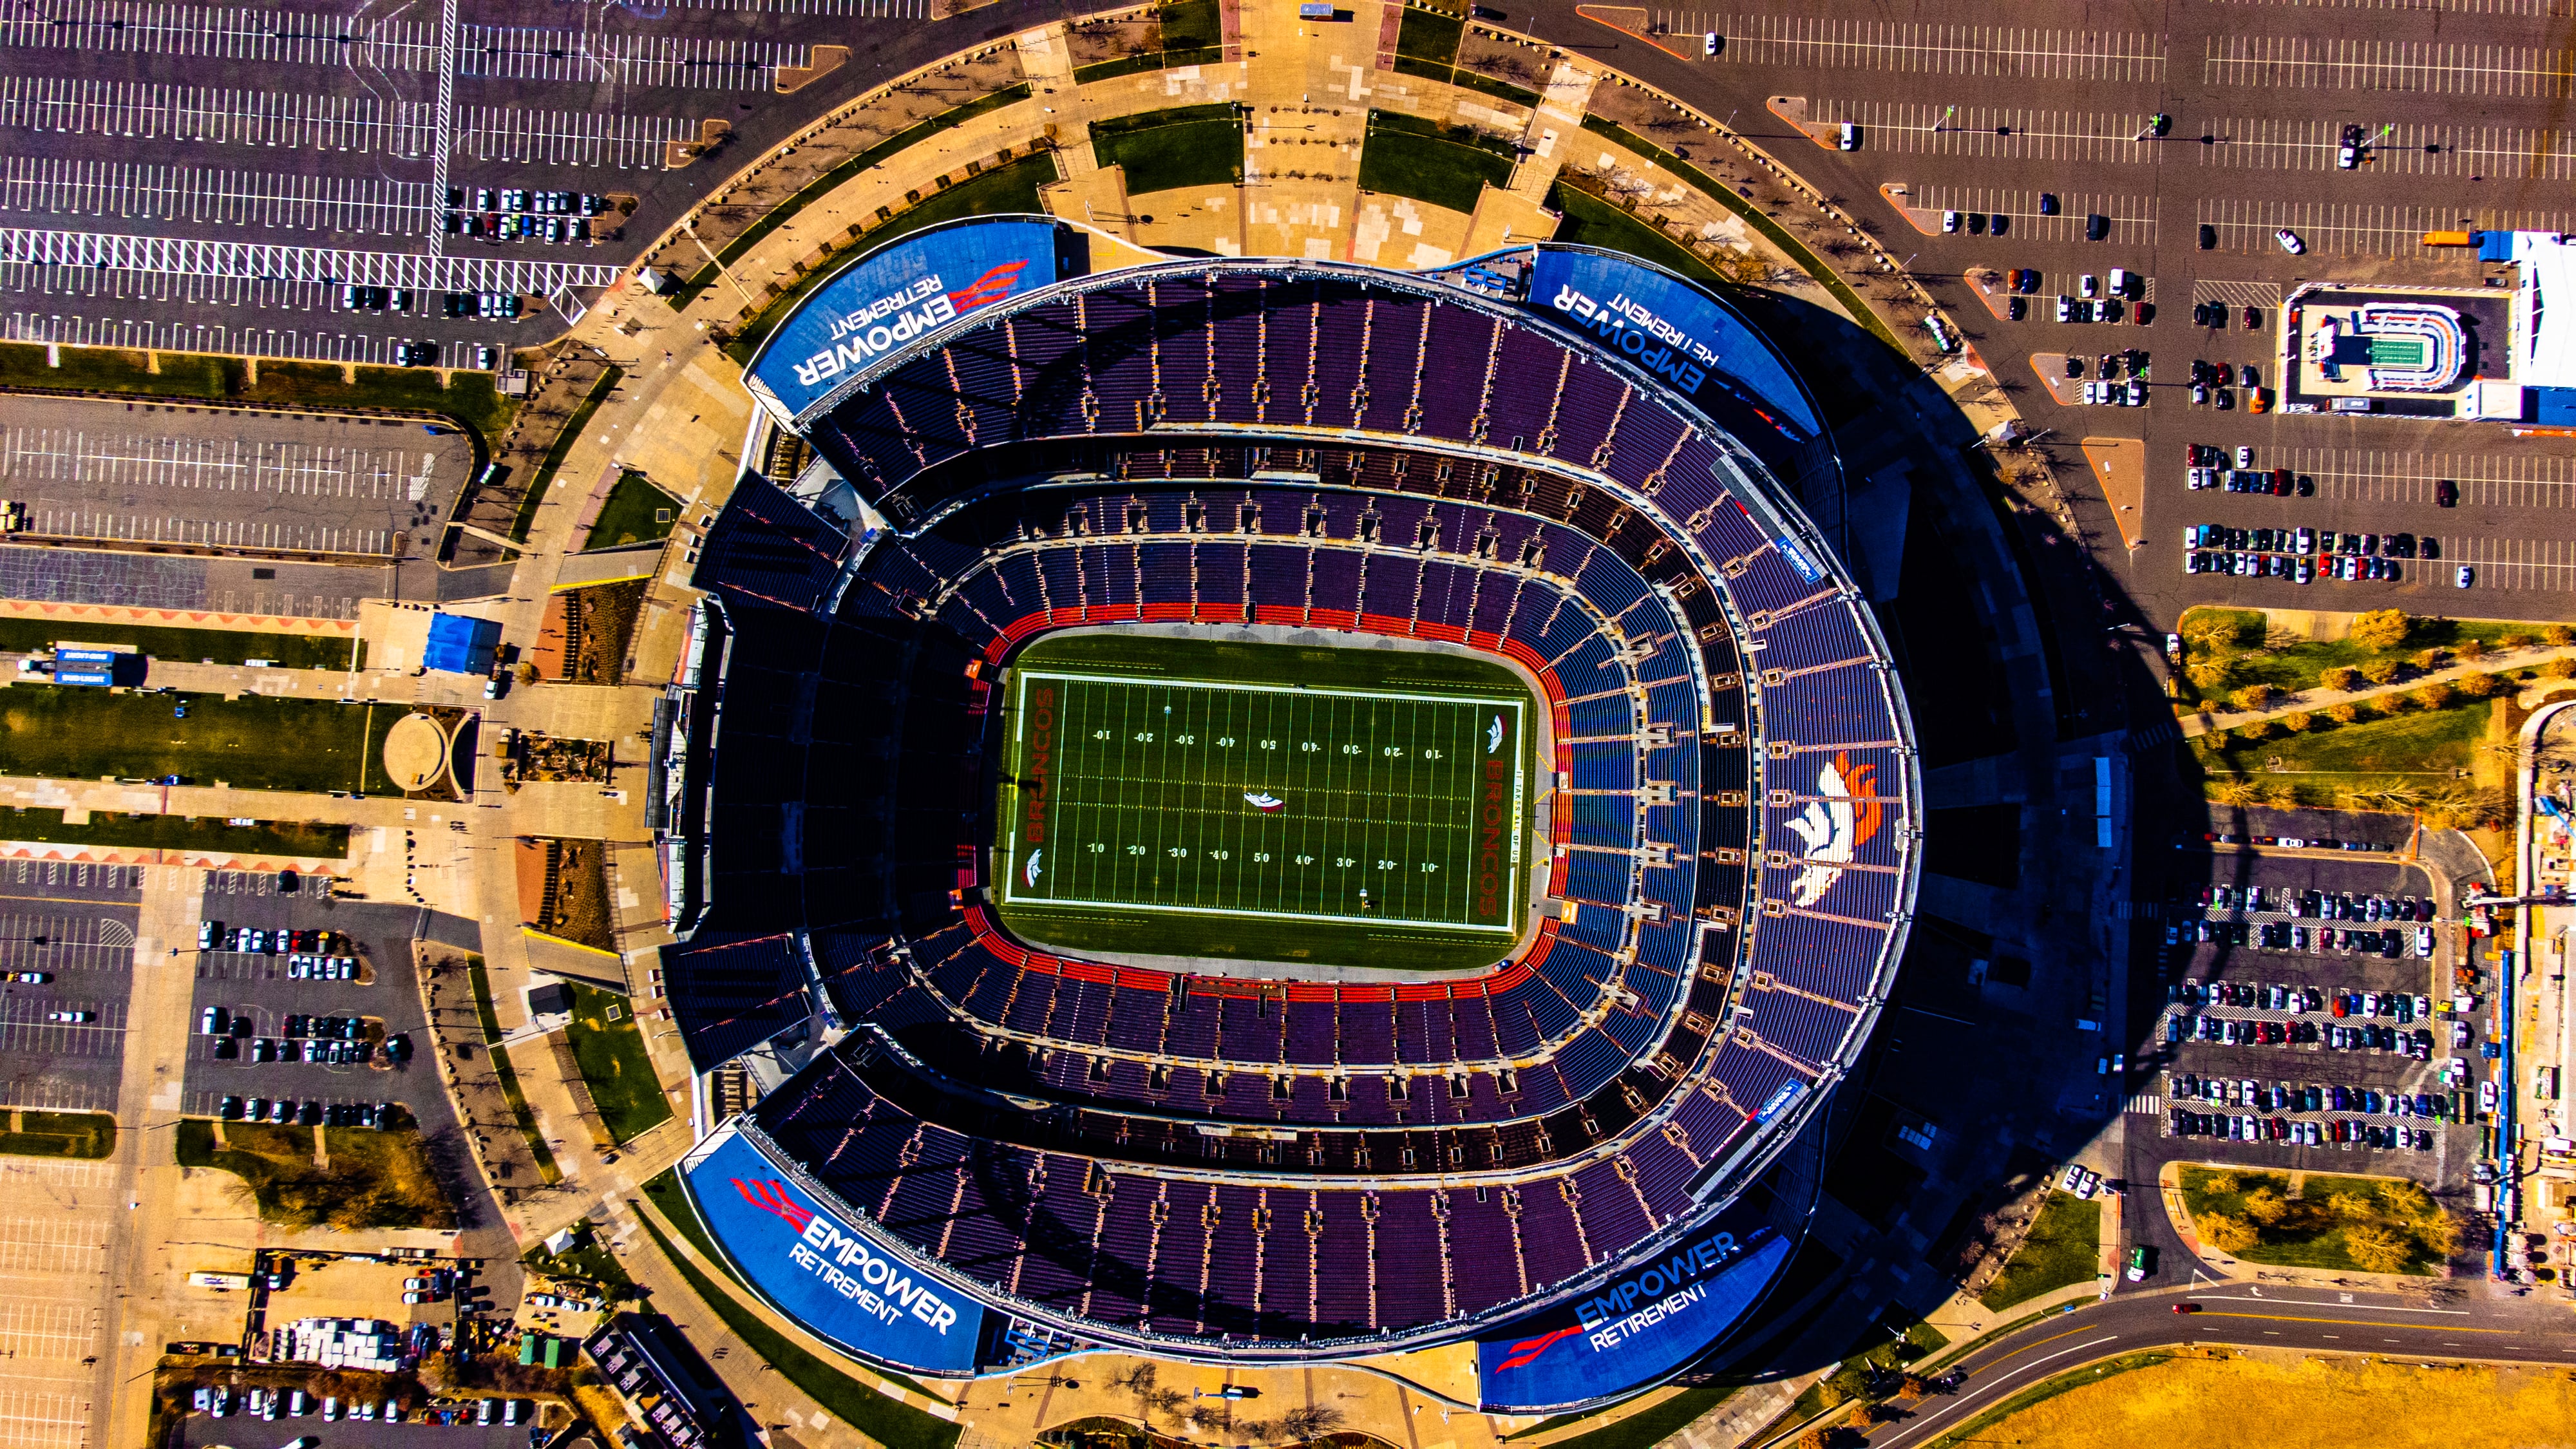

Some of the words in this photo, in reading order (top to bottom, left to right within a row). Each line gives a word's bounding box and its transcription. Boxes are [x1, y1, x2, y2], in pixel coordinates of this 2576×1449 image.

[830, 274, 943, 341] RETIREMENT
[1606, 293, 1720, 366] RETIREMENT
[792, 294, 956, 386] EMPOWER
[1553, 284, 1706, 394] EMPOWER
[1097, 730, 1111, 740] 10
[1137, 733, 1153, 742] 20
[1179, 735, 1195, 744] 30
[1220, 737, 1235, 747] 40
[1261, 740, 1276, 750] 50
[1302, 742, 1318, 752] 40
[1343, 744, 1359, 755] 30
[1385, 747, 1400, 757] 20
[1426, 750, 1439, 759] 10
[1027, 688, 1054, 842] BRONCOS
[1479, 760, 1504, 916] BRONCOS
[1513, 835, 1519, 846] OF
[1090, 843, 1104, 853] 10
[1130, 846, 1146, 855] 20
[1171, 848, 1187, 858] 30
[1213, 850, 1228, 860] 40
[1254, 853, 1269, 862] 50
[1296, 855, 1311, 865] 40
[1511, 850, 1519, 861] US
[1337, 858, 1352, 867] 30
[1378, 860, 1394, 870] 20
[1421, 862, 1435, 873] 10
[802, 1215, 957, 1336] EMPOWER
[789, 1243, 903, 1325] RETIREMENT
[1575, 1231, 1739, 1331] EMPOWER
[1589, 1280, 1707, 1352] RETIREMENT
